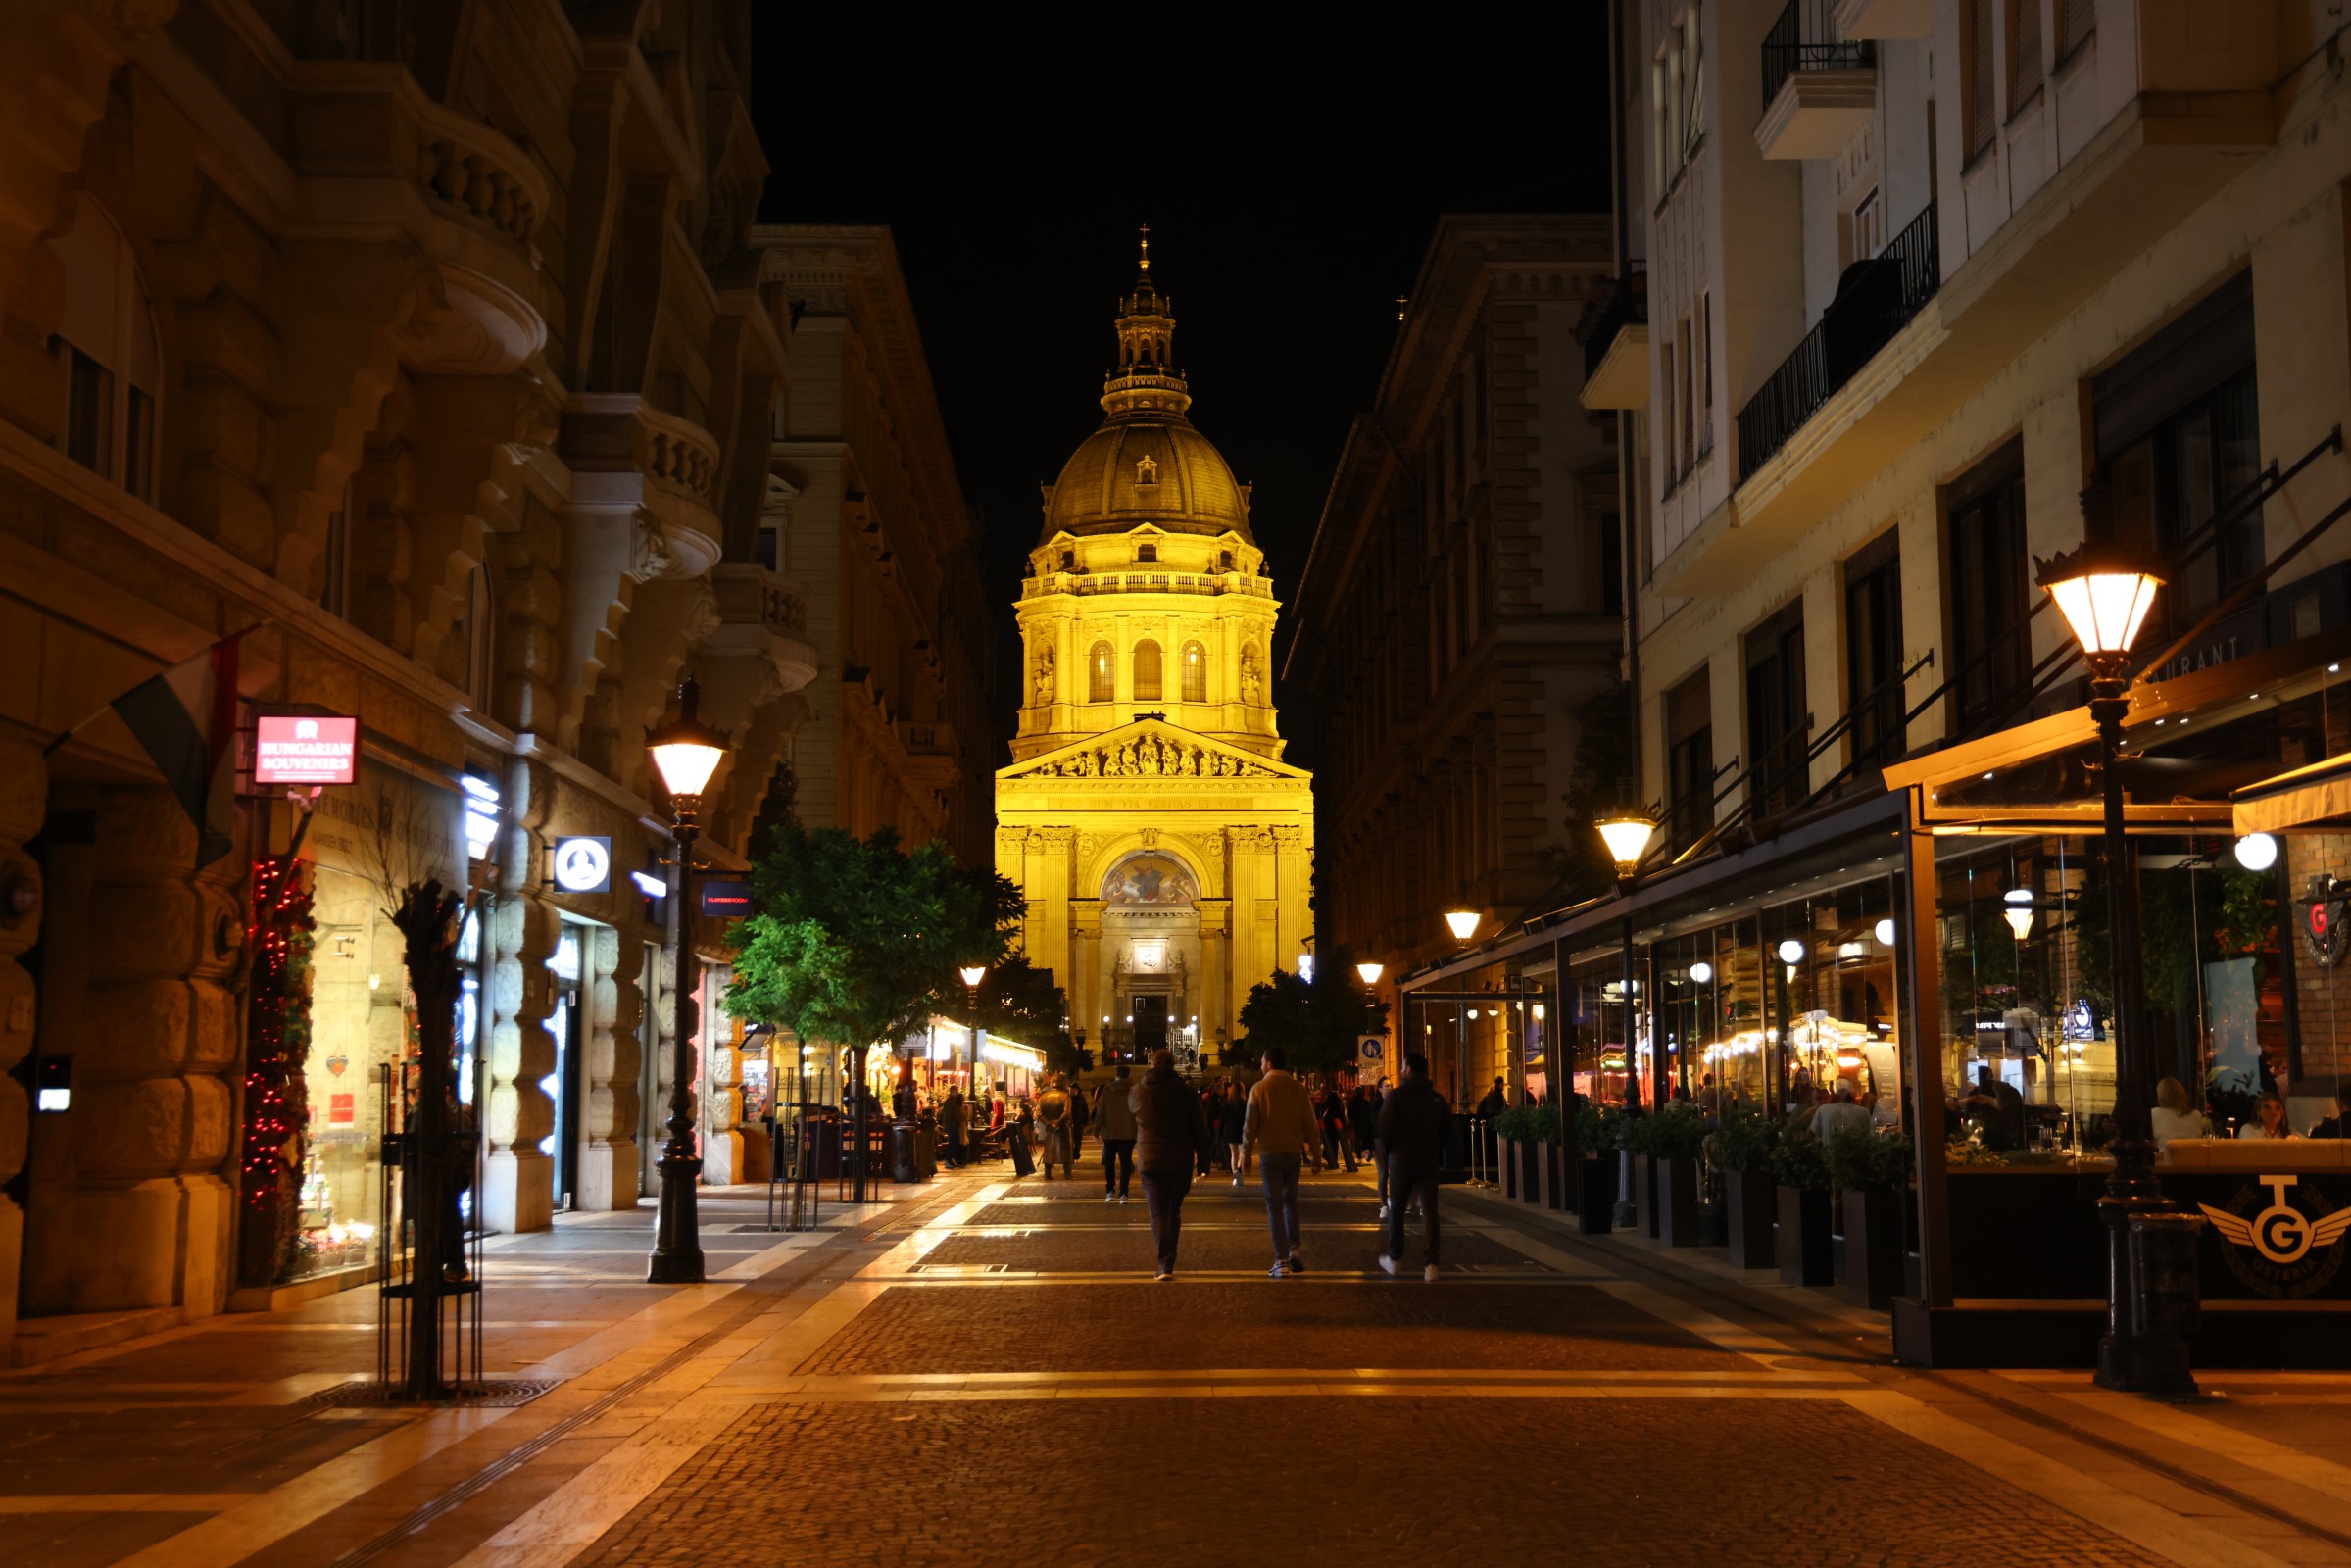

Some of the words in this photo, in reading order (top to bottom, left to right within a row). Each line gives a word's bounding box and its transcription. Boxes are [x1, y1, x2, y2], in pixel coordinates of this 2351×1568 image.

[260, 742, 353, 756] HUNGARIAN
[261, 757, 351, 770] SOUVENIRS
[1059, 798, 1081, 808] EGO
[1089, 798, 1113, 808] SUM
[1121, 798, 1141, 808] VIA
[1198, 798, 1211, 808] ET
[2309, 903, 2328, 935] G
[2252, 1258, 2317, 1282] OSTERIA
